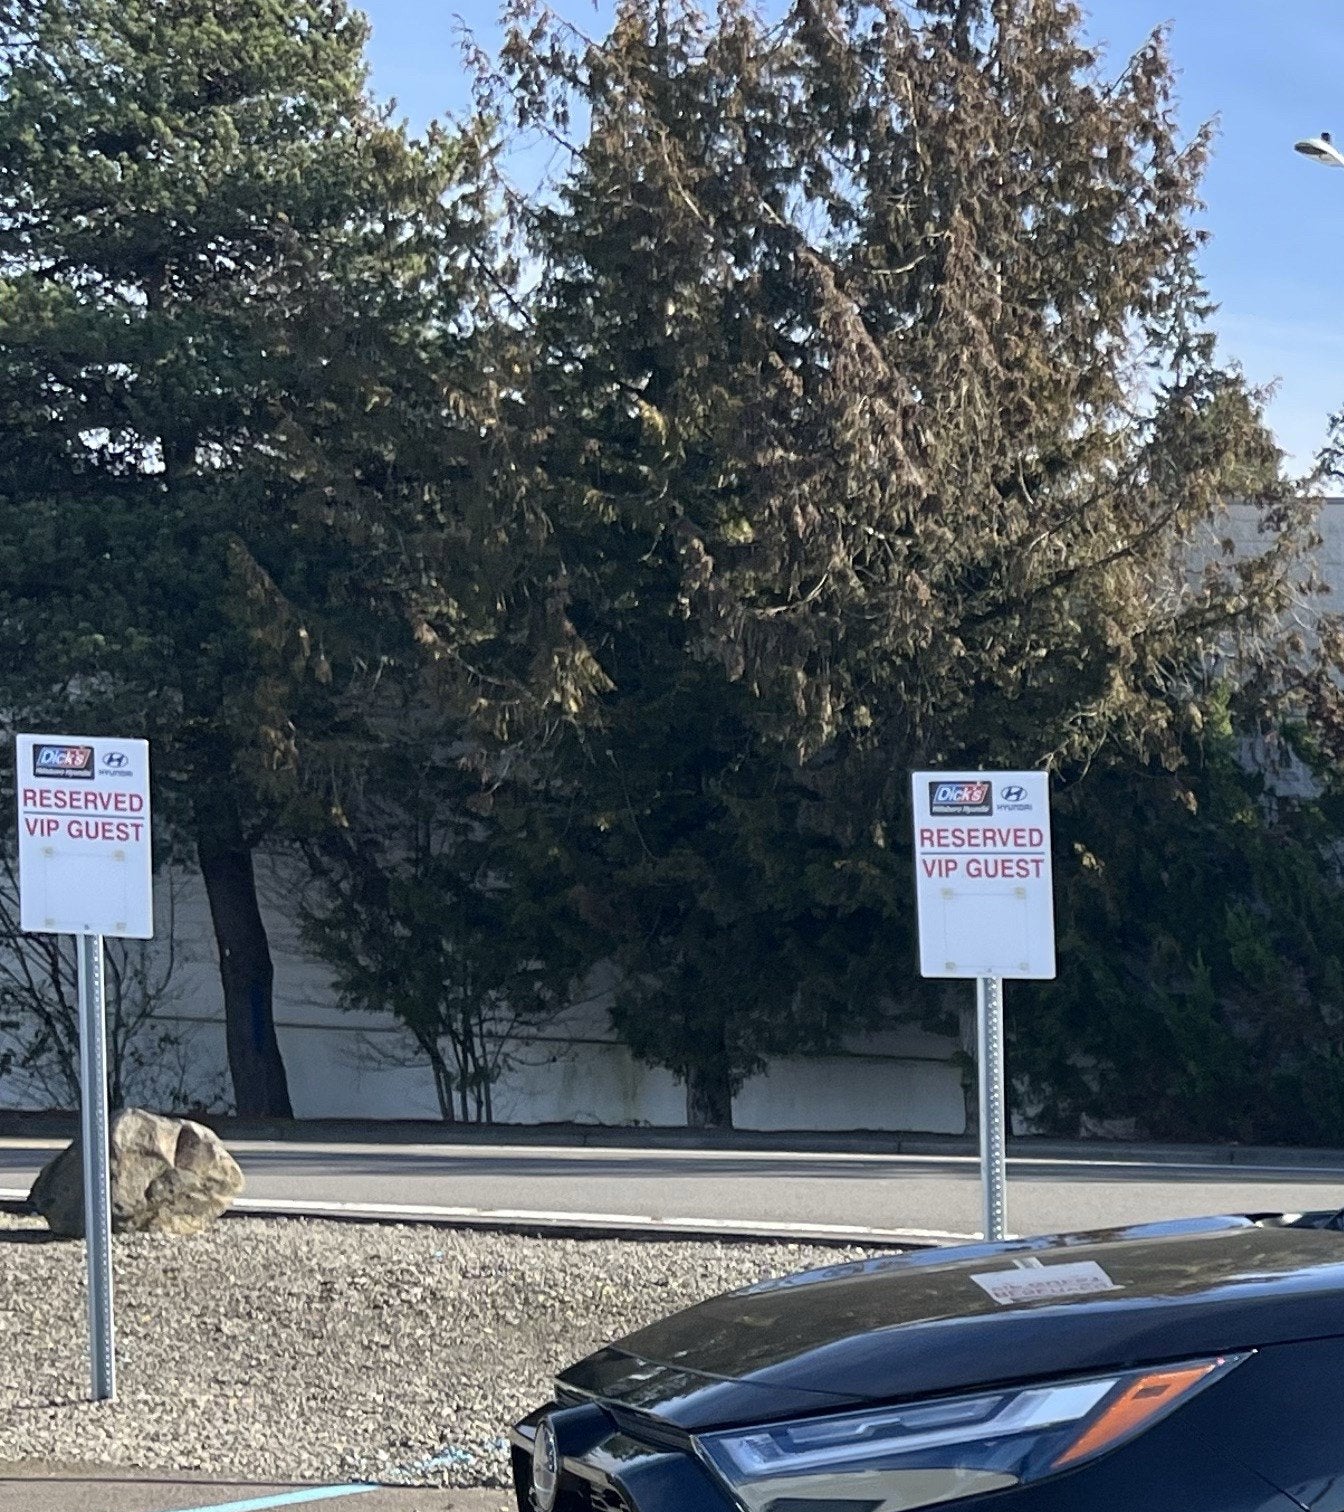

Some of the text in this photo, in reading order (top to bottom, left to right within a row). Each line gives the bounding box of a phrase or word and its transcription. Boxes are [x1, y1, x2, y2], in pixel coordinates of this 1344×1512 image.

[23, 788, 144, 812] RESERVED
[25, 817, 144, 842] VIP GUEST
[920, 828, 1044, 848] RESERVED
[922, 858, 1045, 879] VIP GUEST
